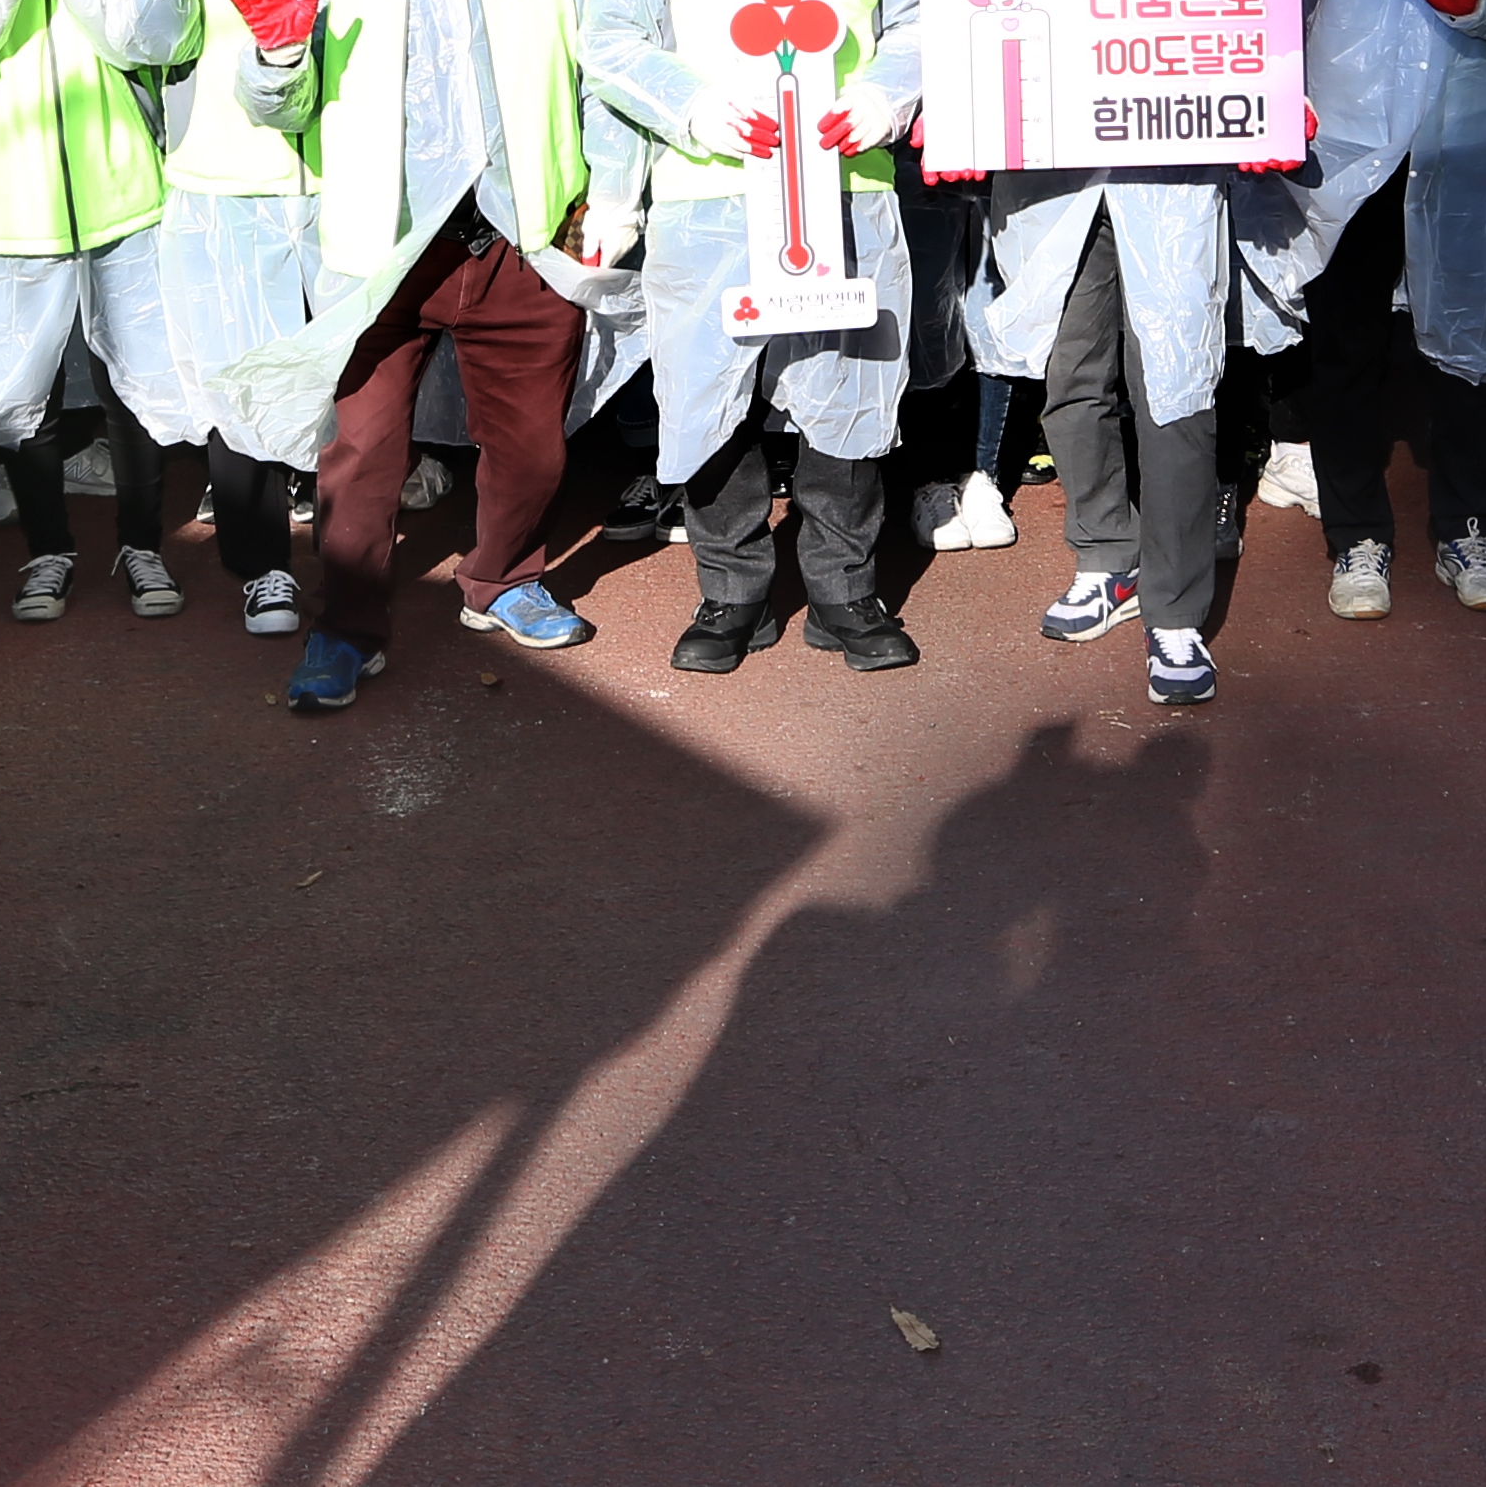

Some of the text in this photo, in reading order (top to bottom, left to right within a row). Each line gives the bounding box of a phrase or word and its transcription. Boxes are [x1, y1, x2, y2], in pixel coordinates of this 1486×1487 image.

[1091, 33, 1265, 76] 100도달성
[1092, 94, 1266, 141] 함께해요!
[766, 290, 865, 314] 사랑의열매
